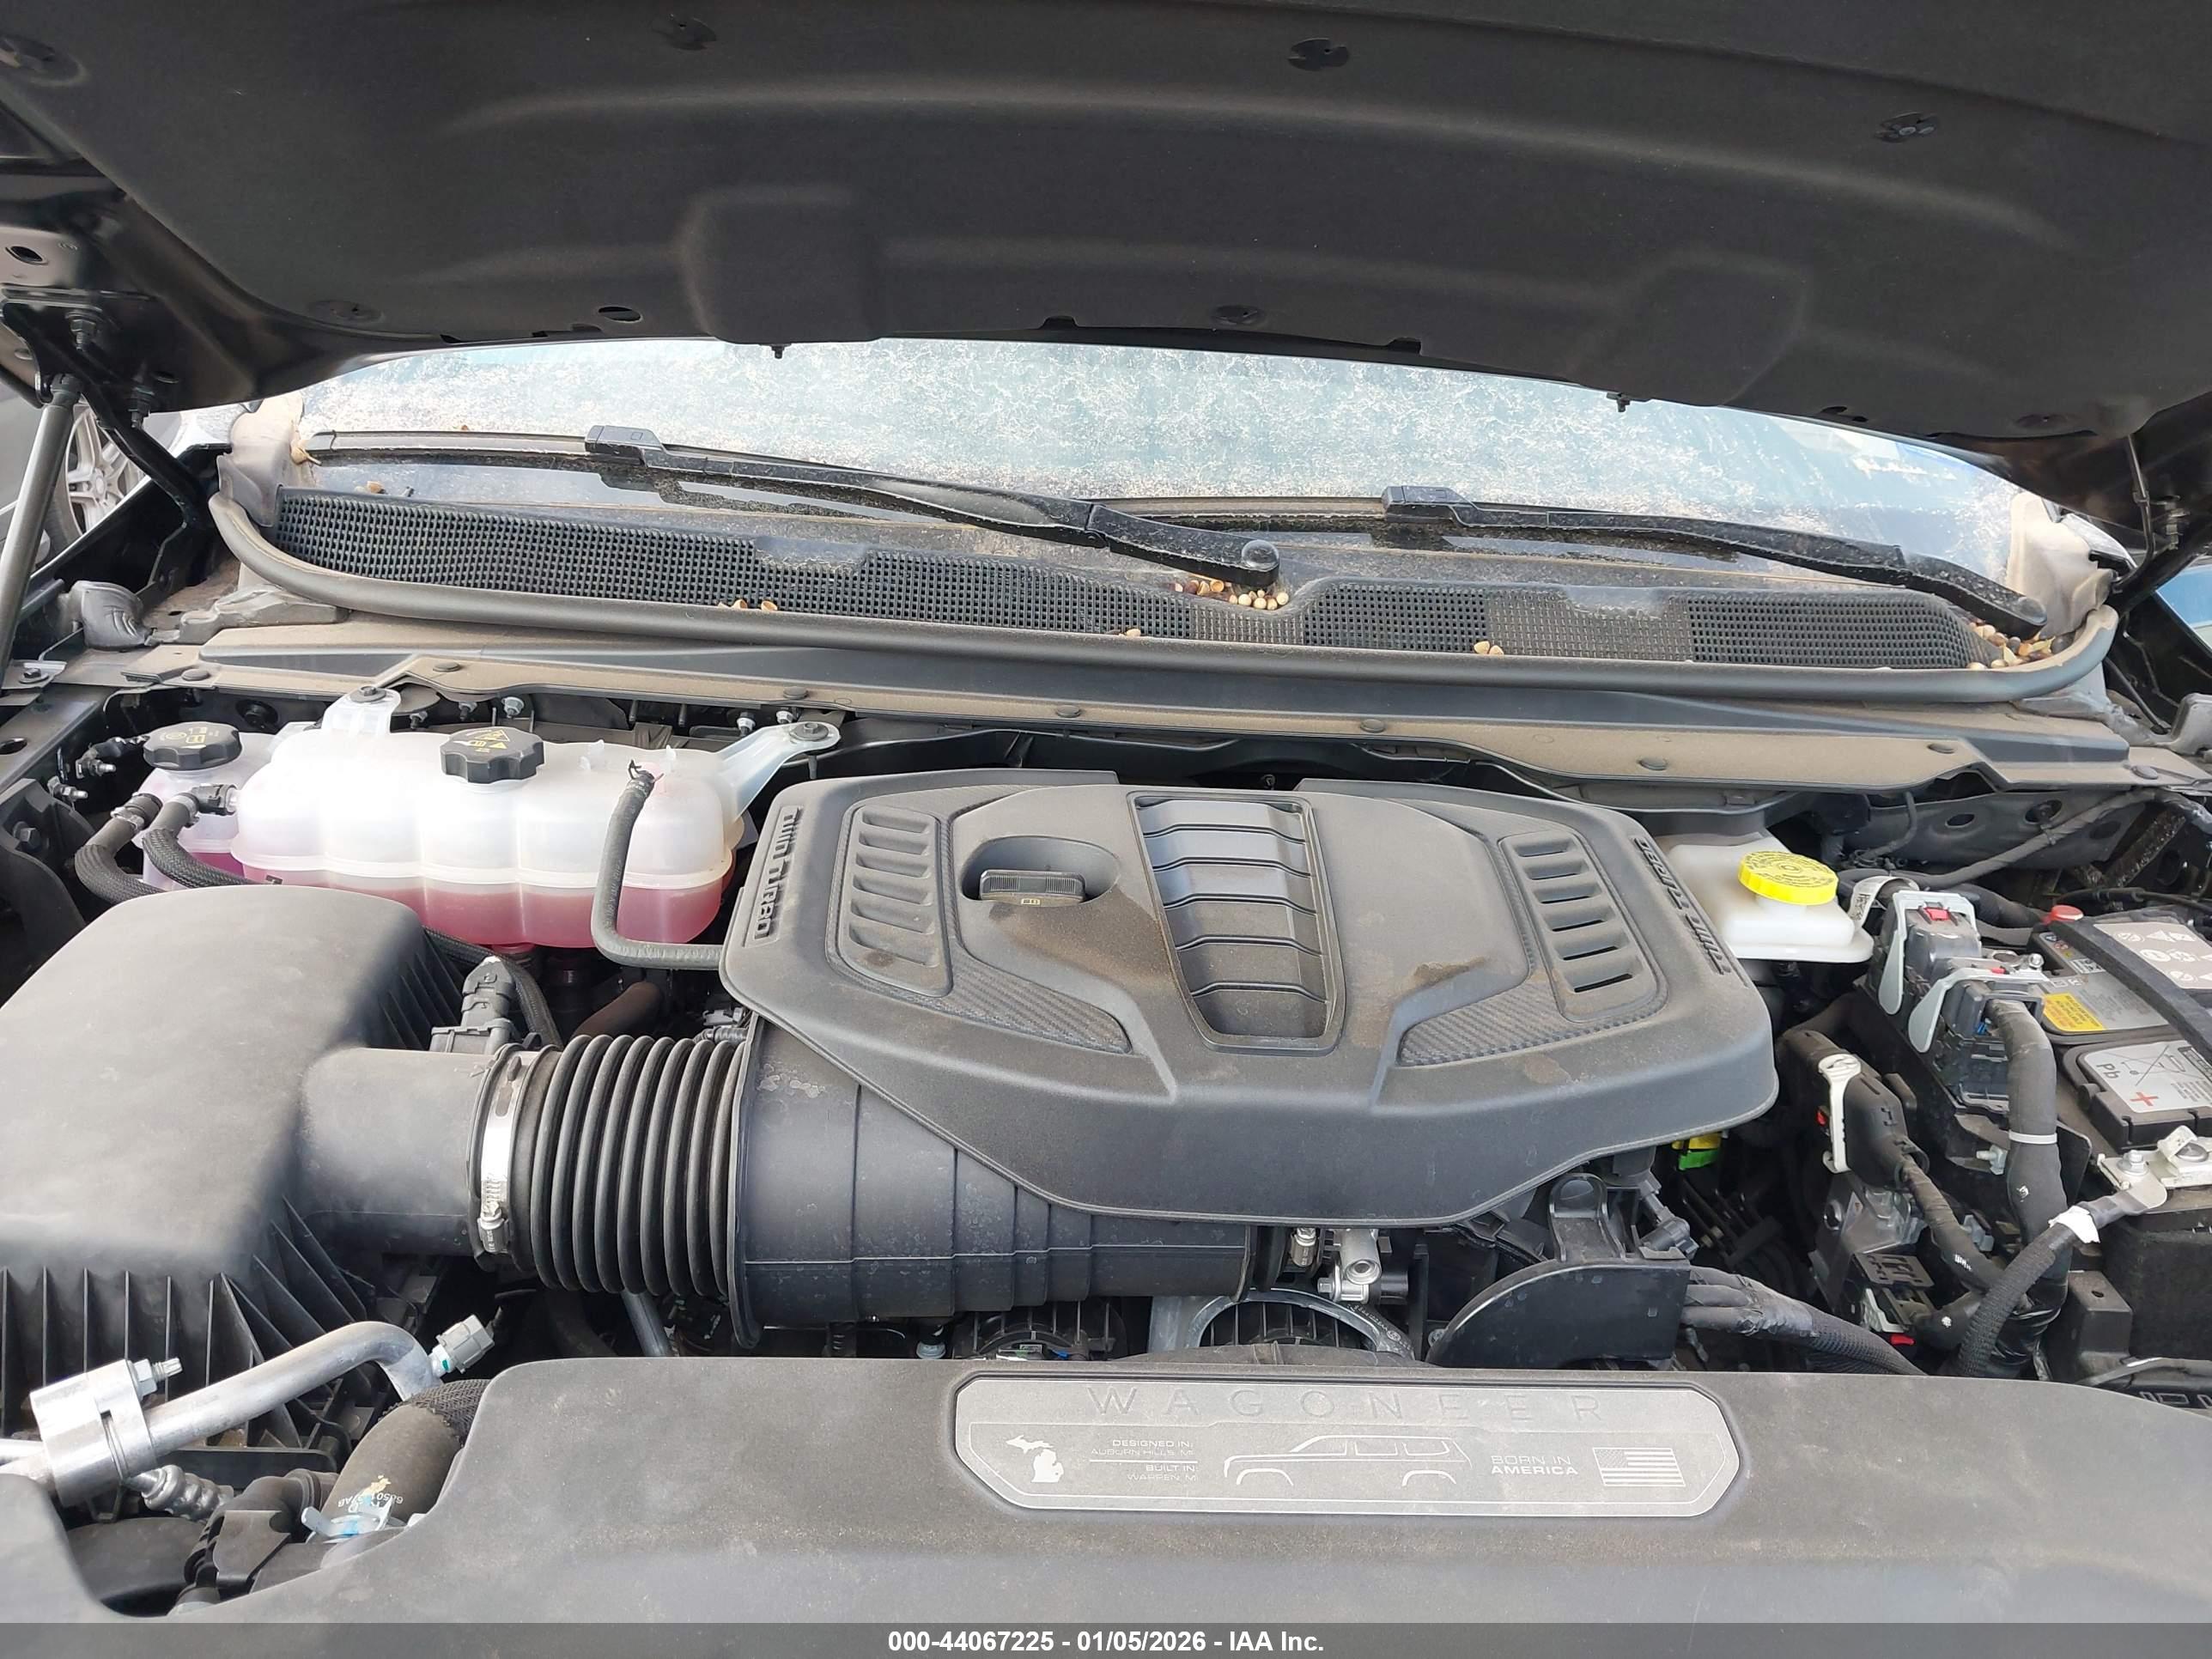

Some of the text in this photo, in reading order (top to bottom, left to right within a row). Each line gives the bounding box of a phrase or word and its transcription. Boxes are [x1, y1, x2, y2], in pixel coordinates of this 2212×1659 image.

[754, 860, 789, 940] TURBO
[2096, 1063, 2121, 1079] Pb
[1086, 1386, 1602, 1422] WAGONEER
[1112, 1439, 1175, 1448] DESIGNED
[1091, 1448, 1140, 1456] AUBURN
[1490, 1455, 1572, 1465] BORN IN
[1491, 1465, 1579, 1475] AMERICA
